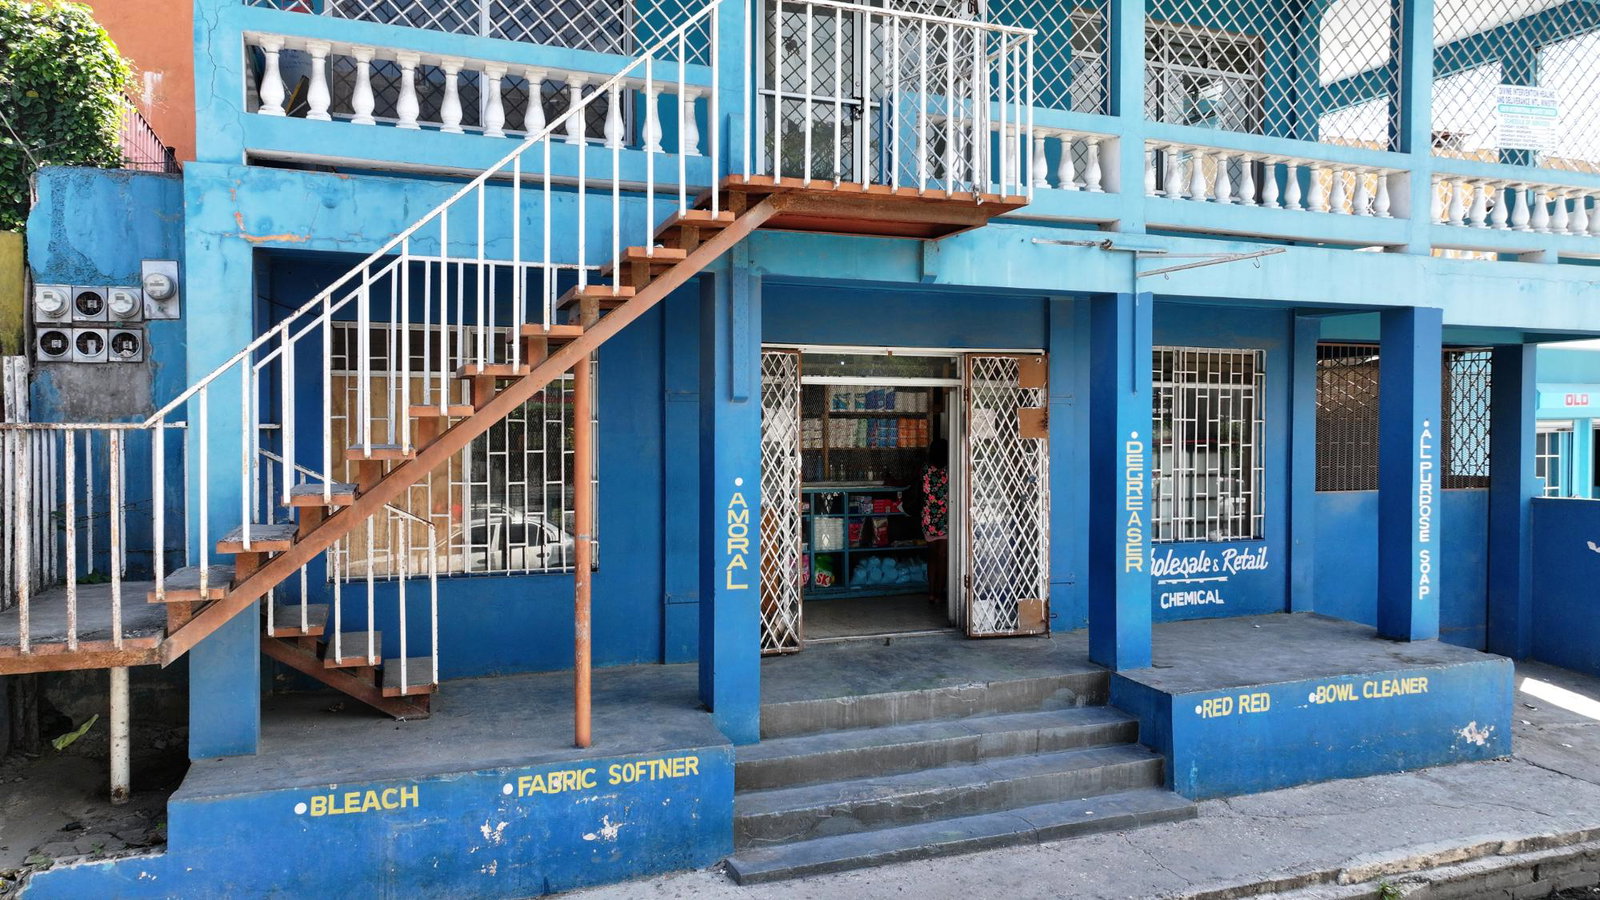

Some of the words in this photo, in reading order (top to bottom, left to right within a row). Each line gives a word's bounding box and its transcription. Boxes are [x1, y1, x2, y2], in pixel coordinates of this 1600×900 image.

[1565, 394, 1589, 406] OLD
[1420, 429, 1432, 459] ALL
[1126, 441, 1144, 573] DEGREASER
[1419, 462, 1432, 543] PURPOSE
[726, 492, 749, 590] AMORAL
[1151, 547, 1211, 578] holesale
[1221, 546, 1269, 575] Retail
[1419, 549, 1431, 600] SOAP
[1160, 589, 1225, 609] CHEMICAL
[1202, 696, 1234, 719] RED
[1238, 692, 1271, 714] RED
[1316, 684, 1358, 704] BOWL
[1363, 677, 1428, 699] CLEANER
[518, 767, 597, 797] FABRIC
[608, 756, 699, 786] SOFTNER
[310, 785, 419, 817] BLEACH
